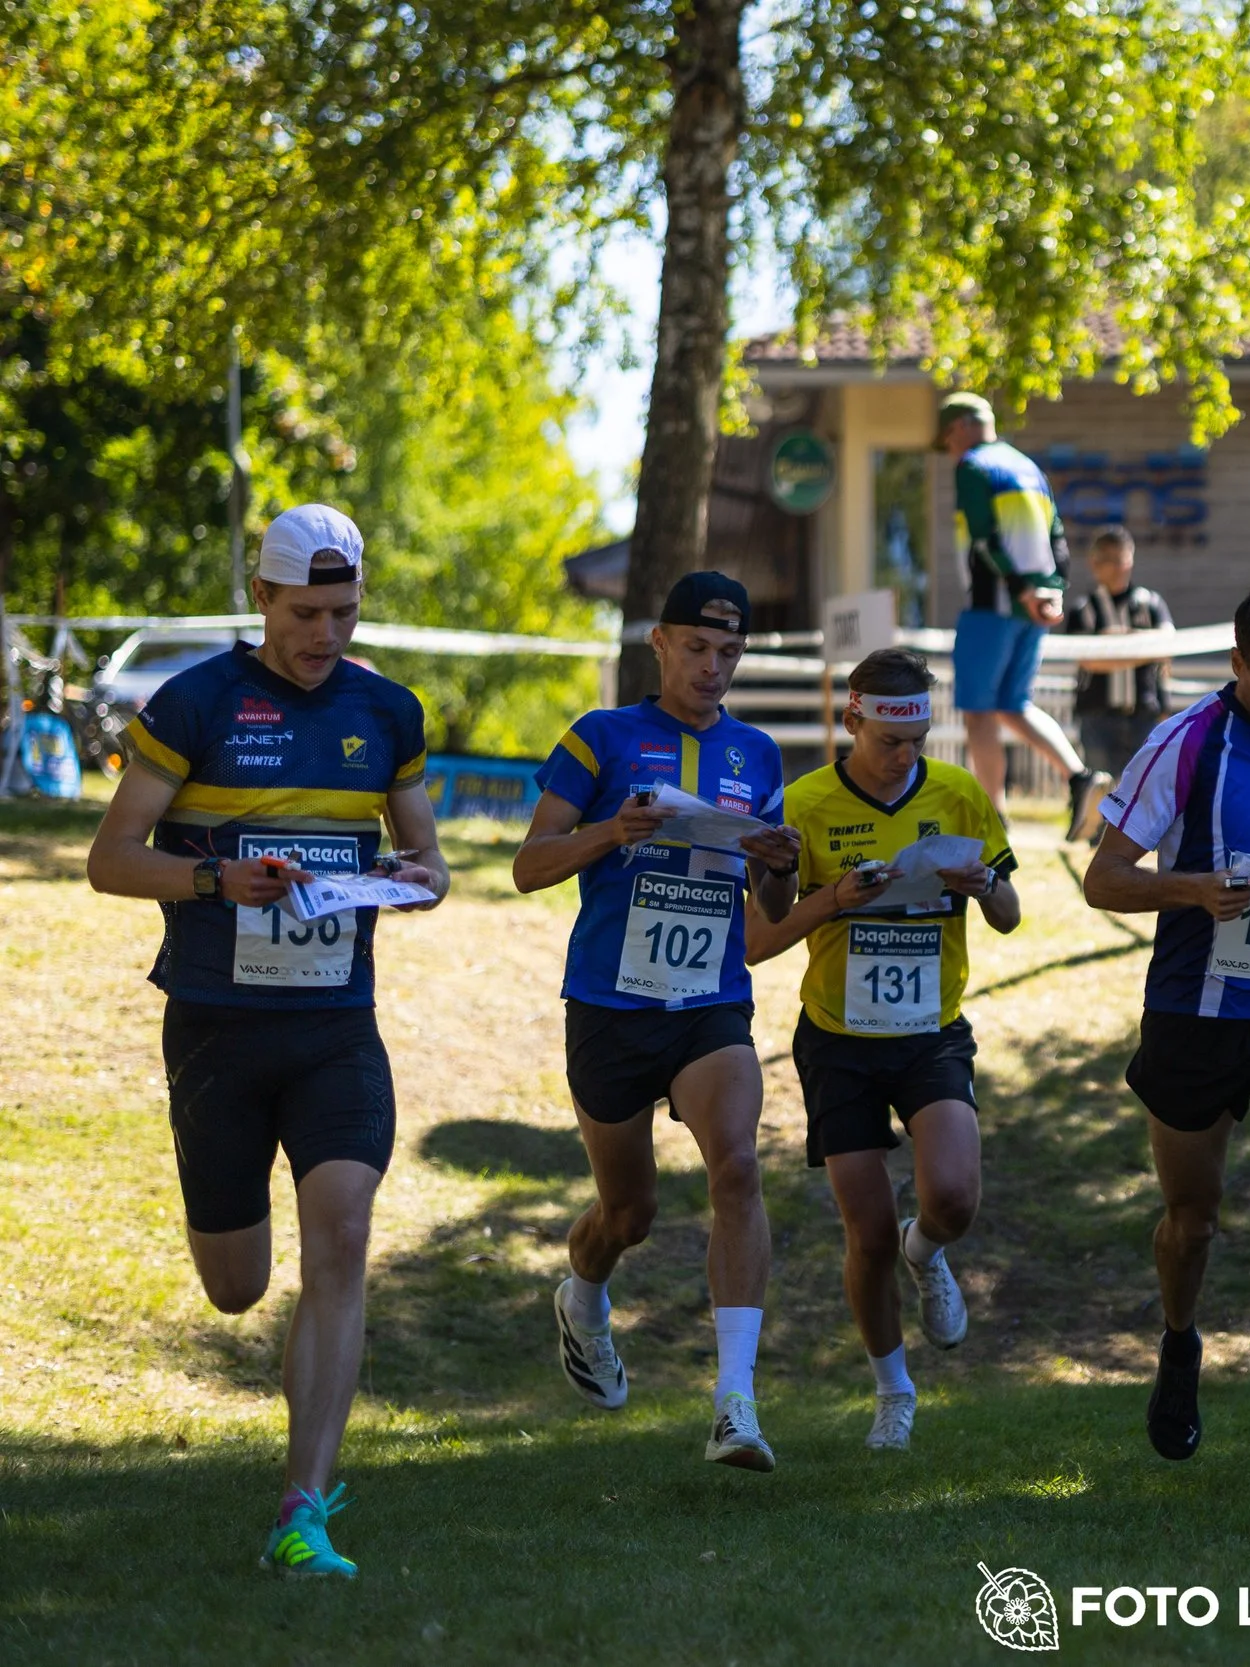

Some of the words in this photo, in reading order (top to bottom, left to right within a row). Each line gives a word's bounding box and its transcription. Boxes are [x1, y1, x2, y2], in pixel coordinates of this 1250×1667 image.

[238, 713, 280, 721] KVANTUM
[225, 734, 285, 745] JUNET
[236, 755, 283, 766] TRIMTEX
[828, 822, 875, 837] TRIMTEX
[637, 845, 670, 858] rofura
[640, 878, 730, 904] bagheera
[648, 899, 660, 907] SM
[664, 903, 713, 914] SPRINTDISTANS
[854, 928, 939, 945] bagheera
[645, 921, 713, 969] 102
[301, 968, 349, 977] VOLVO
[864, 965, 921, 1005] 131
